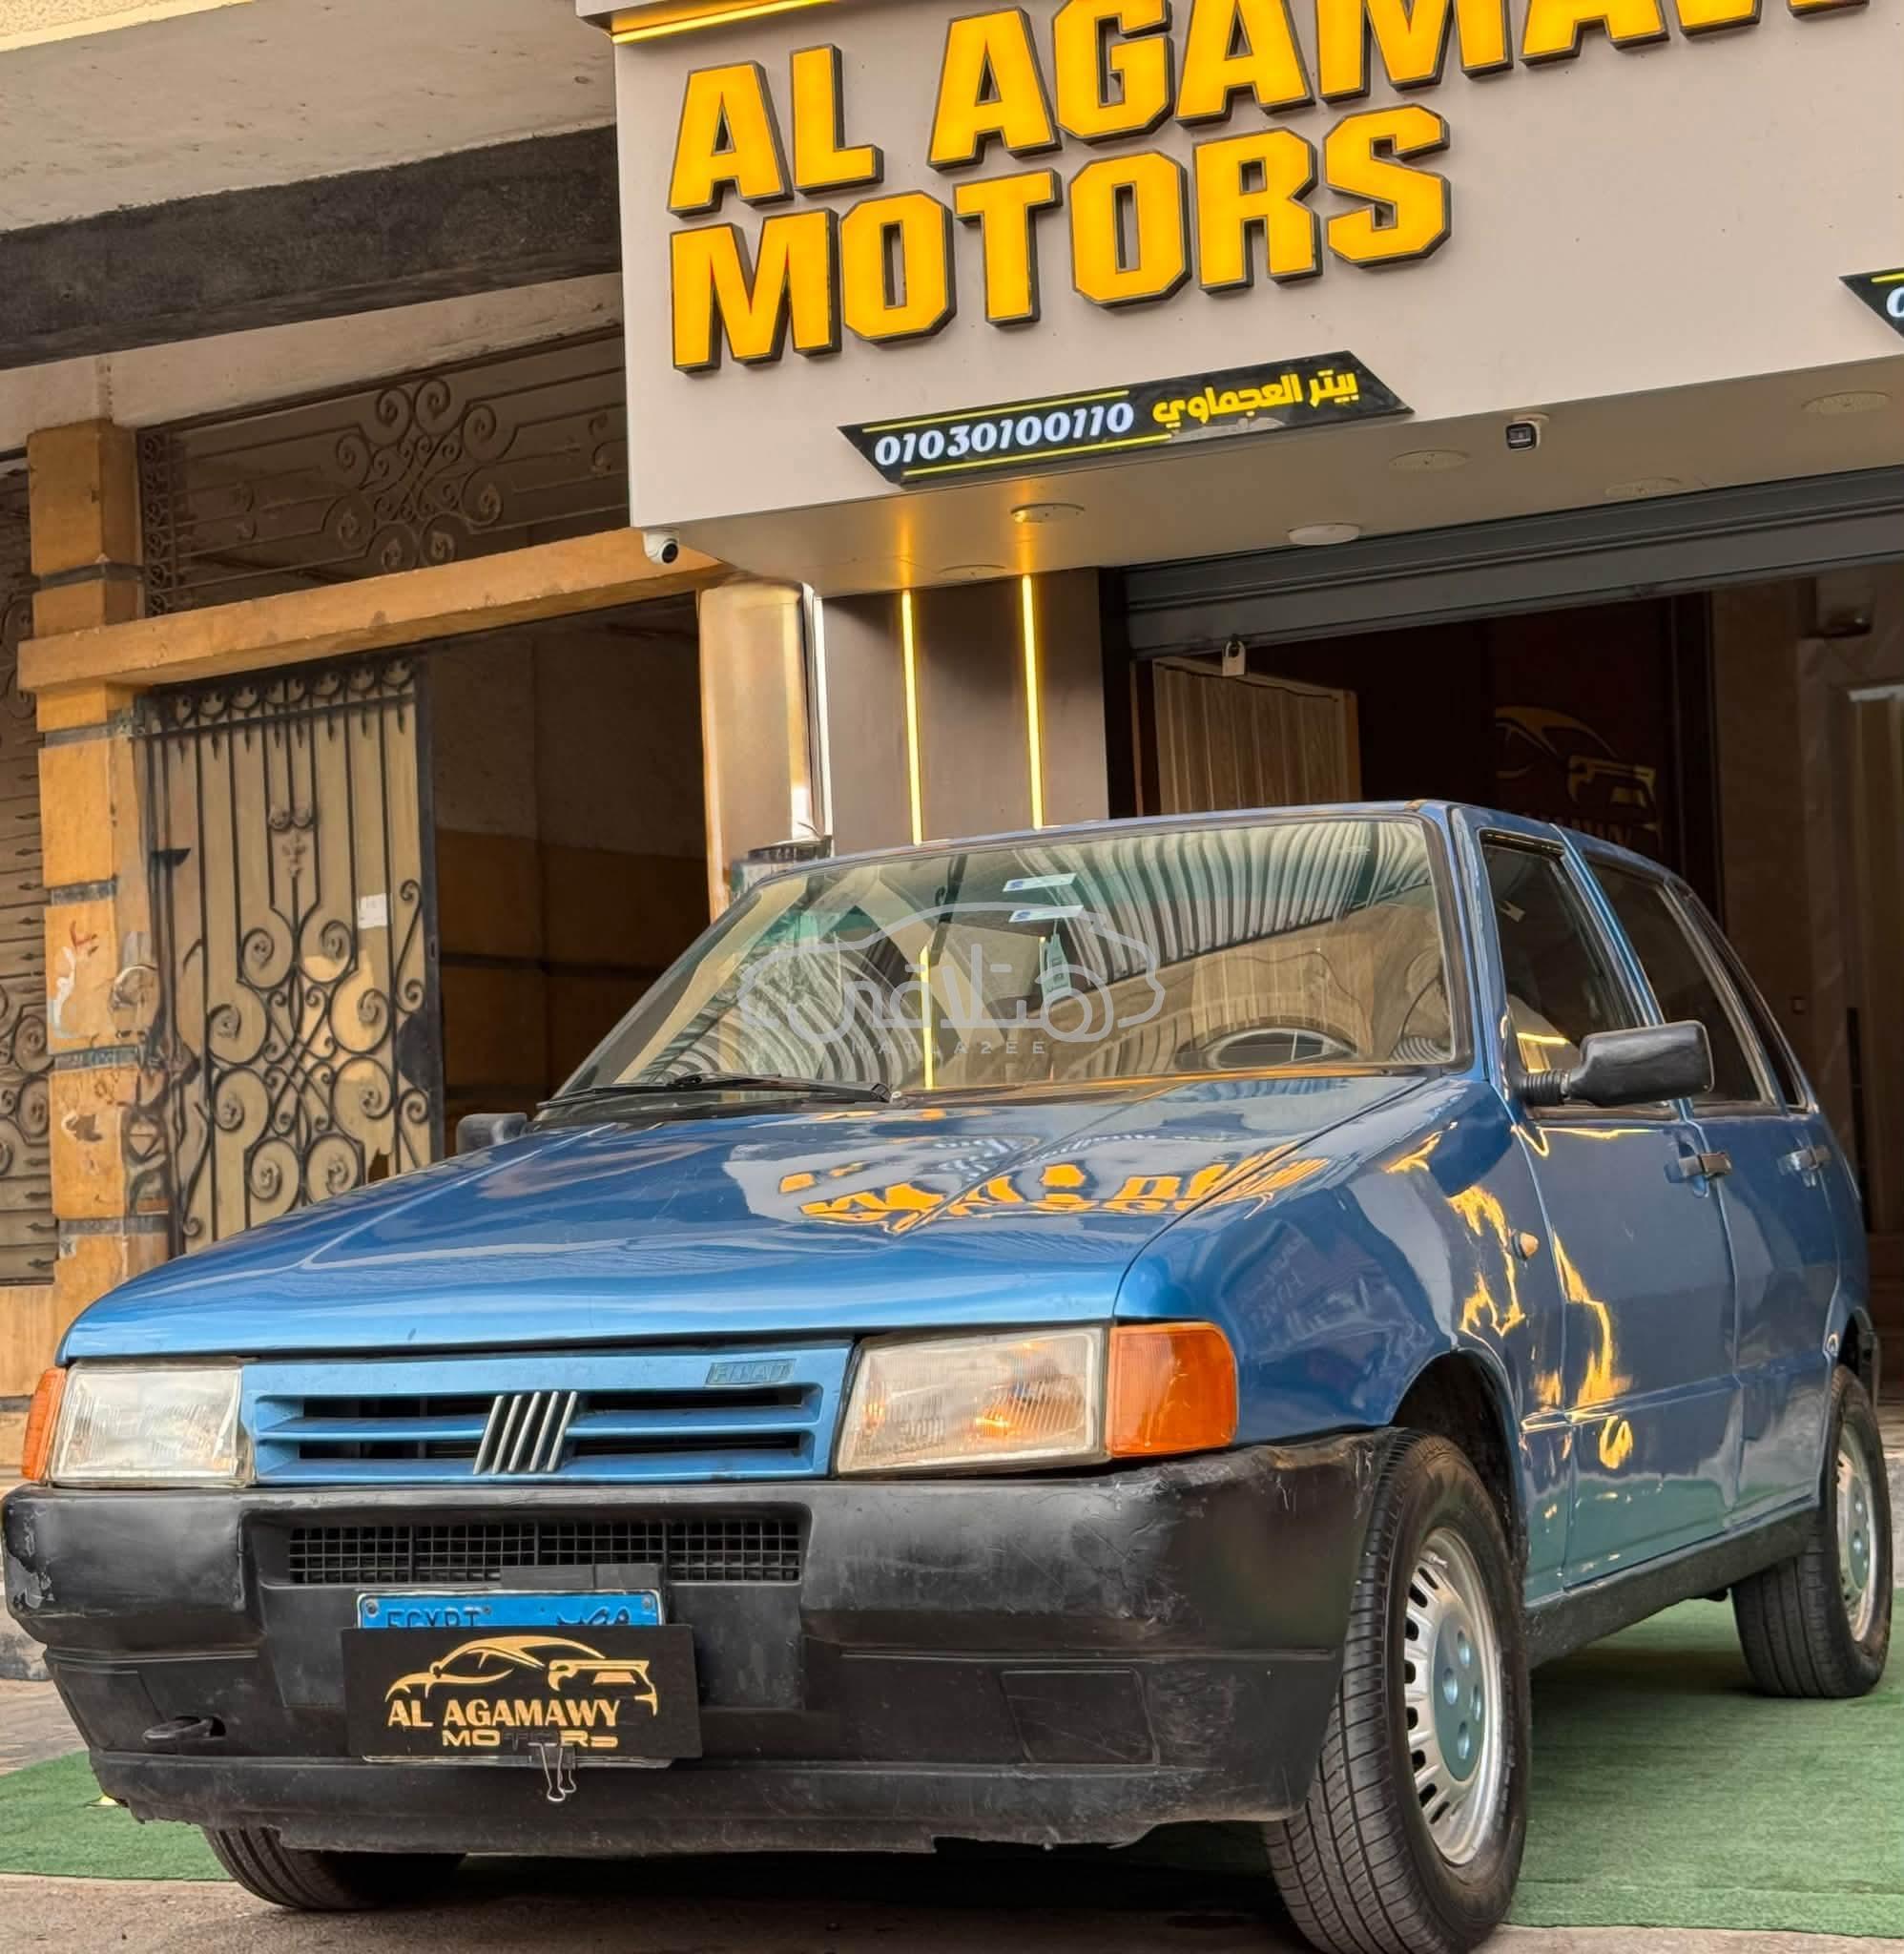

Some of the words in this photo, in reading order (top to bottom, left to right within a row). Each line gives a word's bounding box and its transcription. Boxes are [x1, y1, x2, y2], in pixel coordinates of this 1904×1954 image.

[668, 44, 884, 216] AL
[670, 103, 1451, 374] MOTORS
[1151, 372, 1304, 429] العجماوي
[1309, 368, 1359, 408] بيتر
[874, 402, 1135, 467] 01030100110
[387, 1698, 434, 1728] AL
[442, 1698, 621, 1728] AGAMAWY
